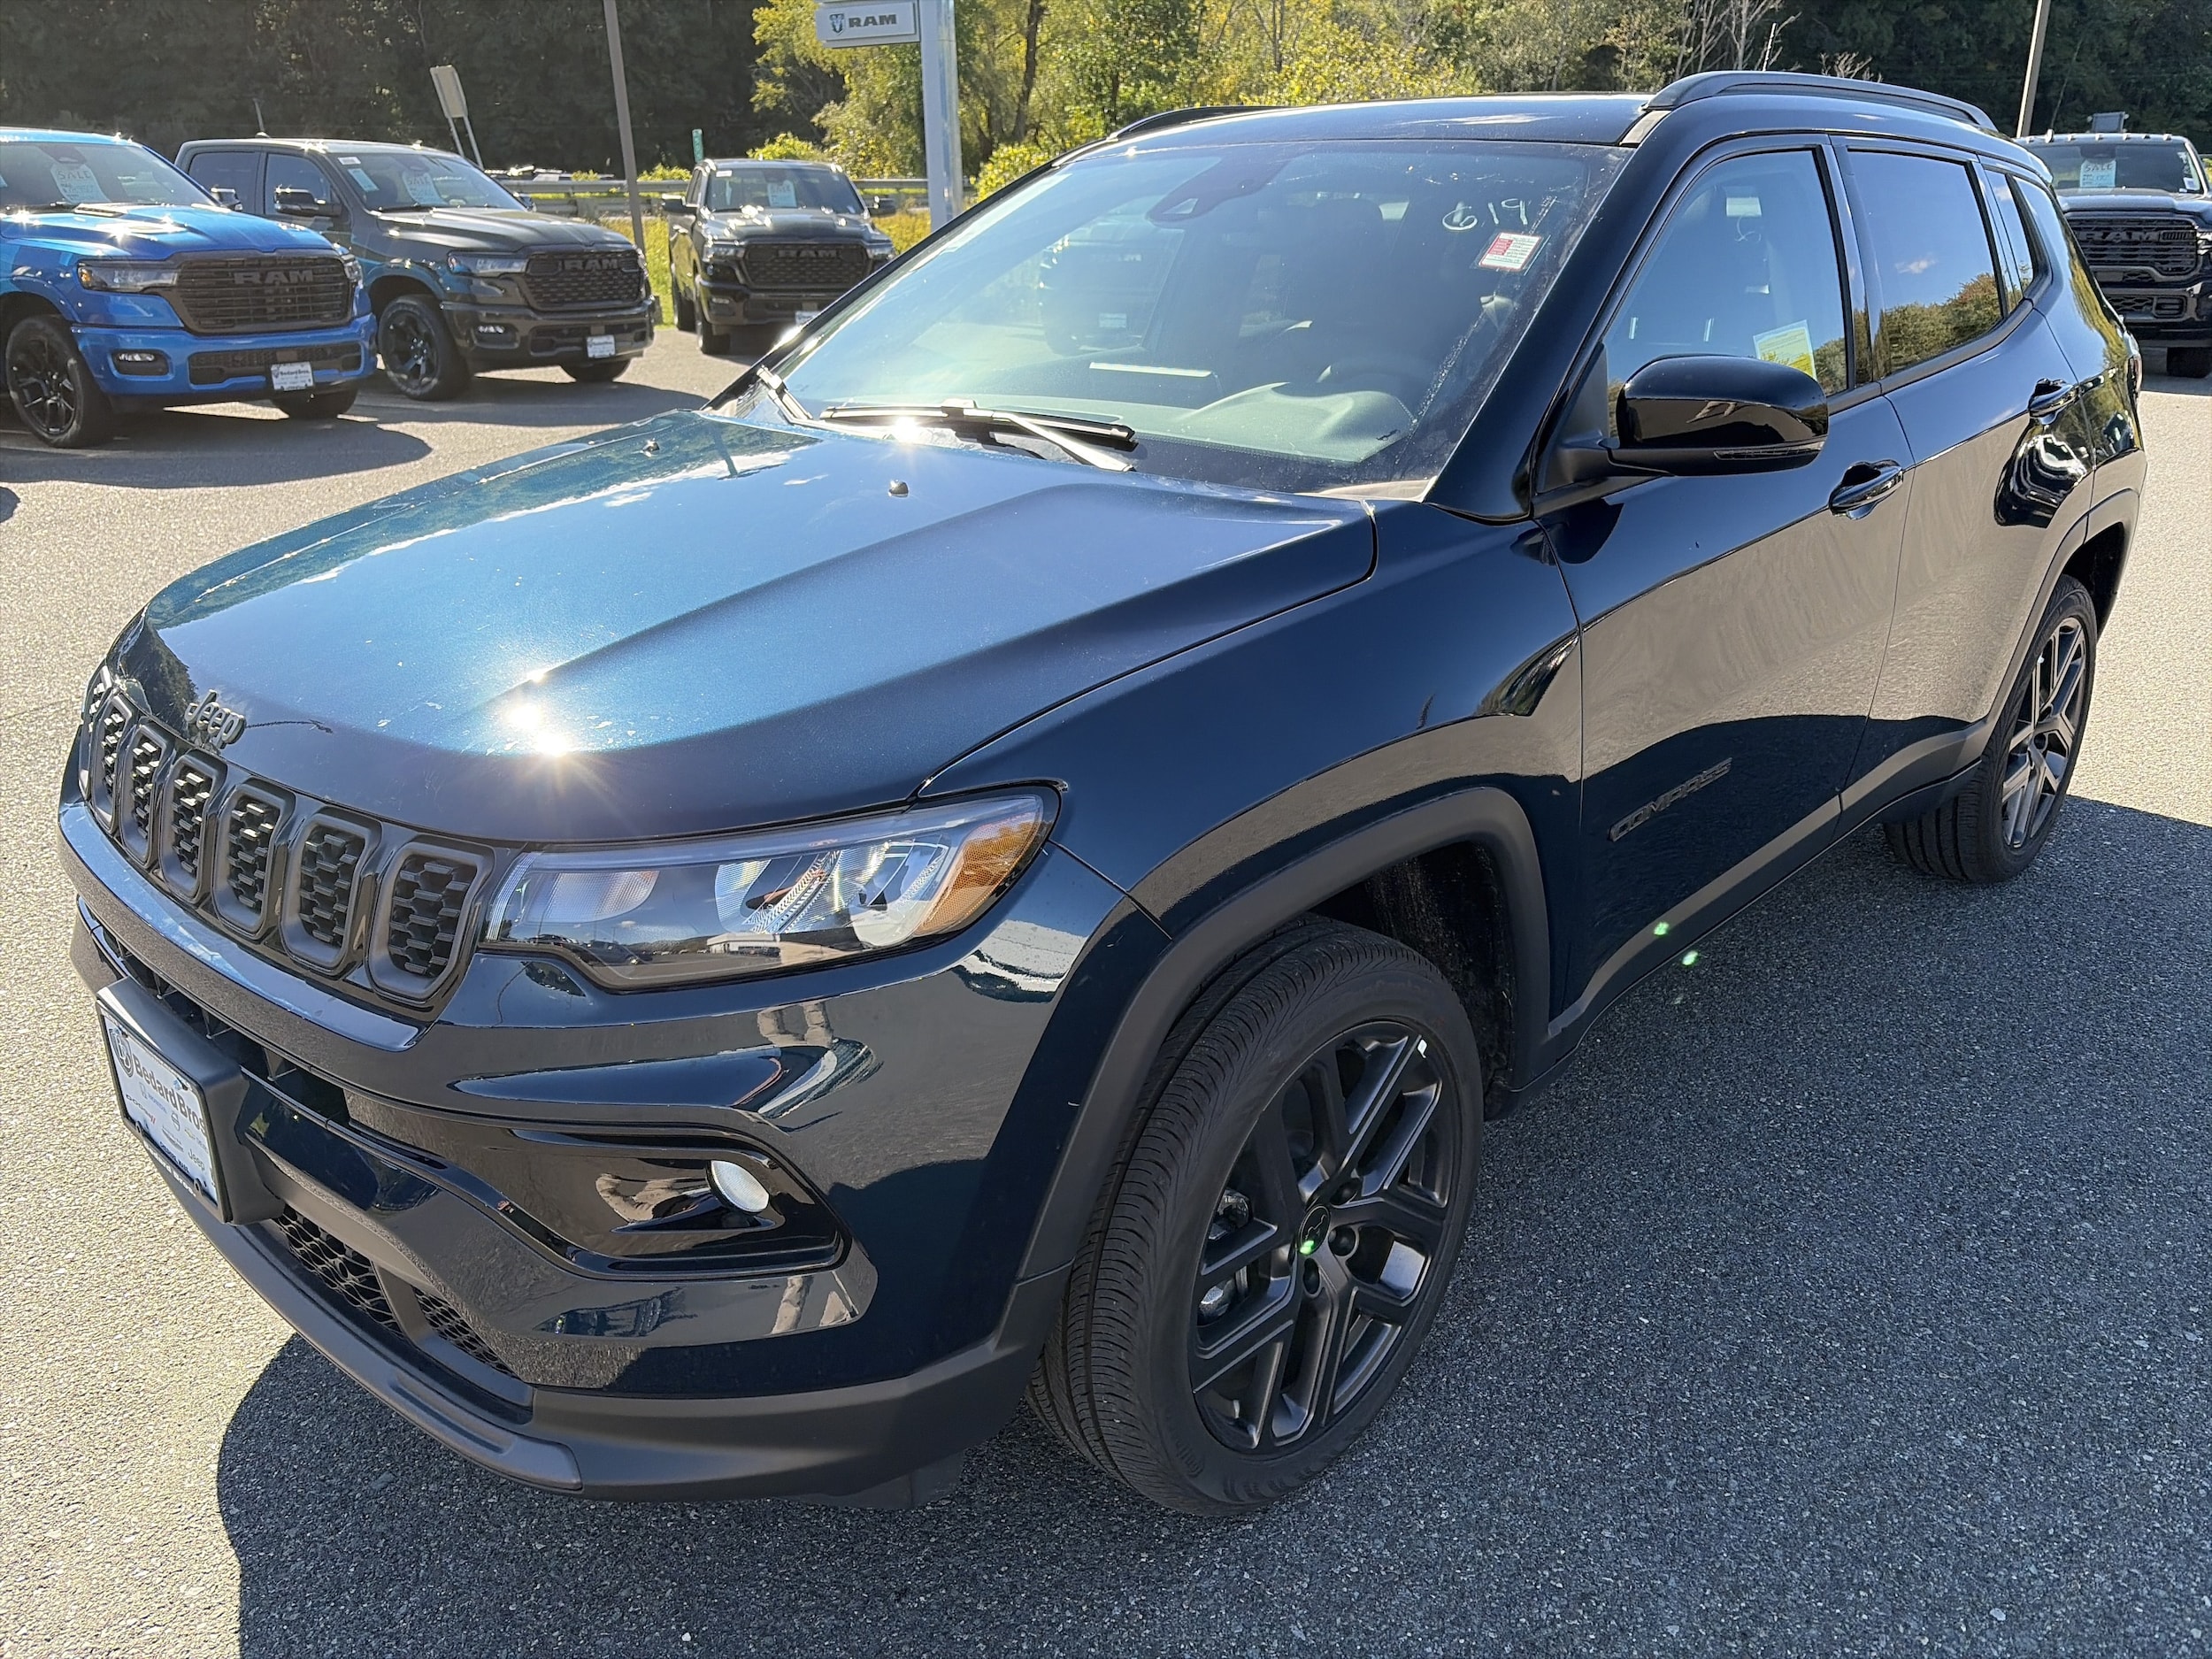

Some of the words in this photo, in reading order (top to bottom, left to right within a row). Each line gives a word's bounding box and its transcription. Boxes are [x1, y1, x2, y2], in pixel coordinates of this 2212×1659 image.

[848, 14, 897, 27] RAM
[58, 170, 92, 180] SALE
[2078, 231, 2161, 242] RAM
[777, 249, 838, 258] RAM
[564, 257, 618, 271] RAM
[234, 269, 314, 285] RAM
[184, 688, 246, 749] Jeep
[1609, 757, 1732, 842] COMPASS
[188, 1148, 205, 1171] Jeep
